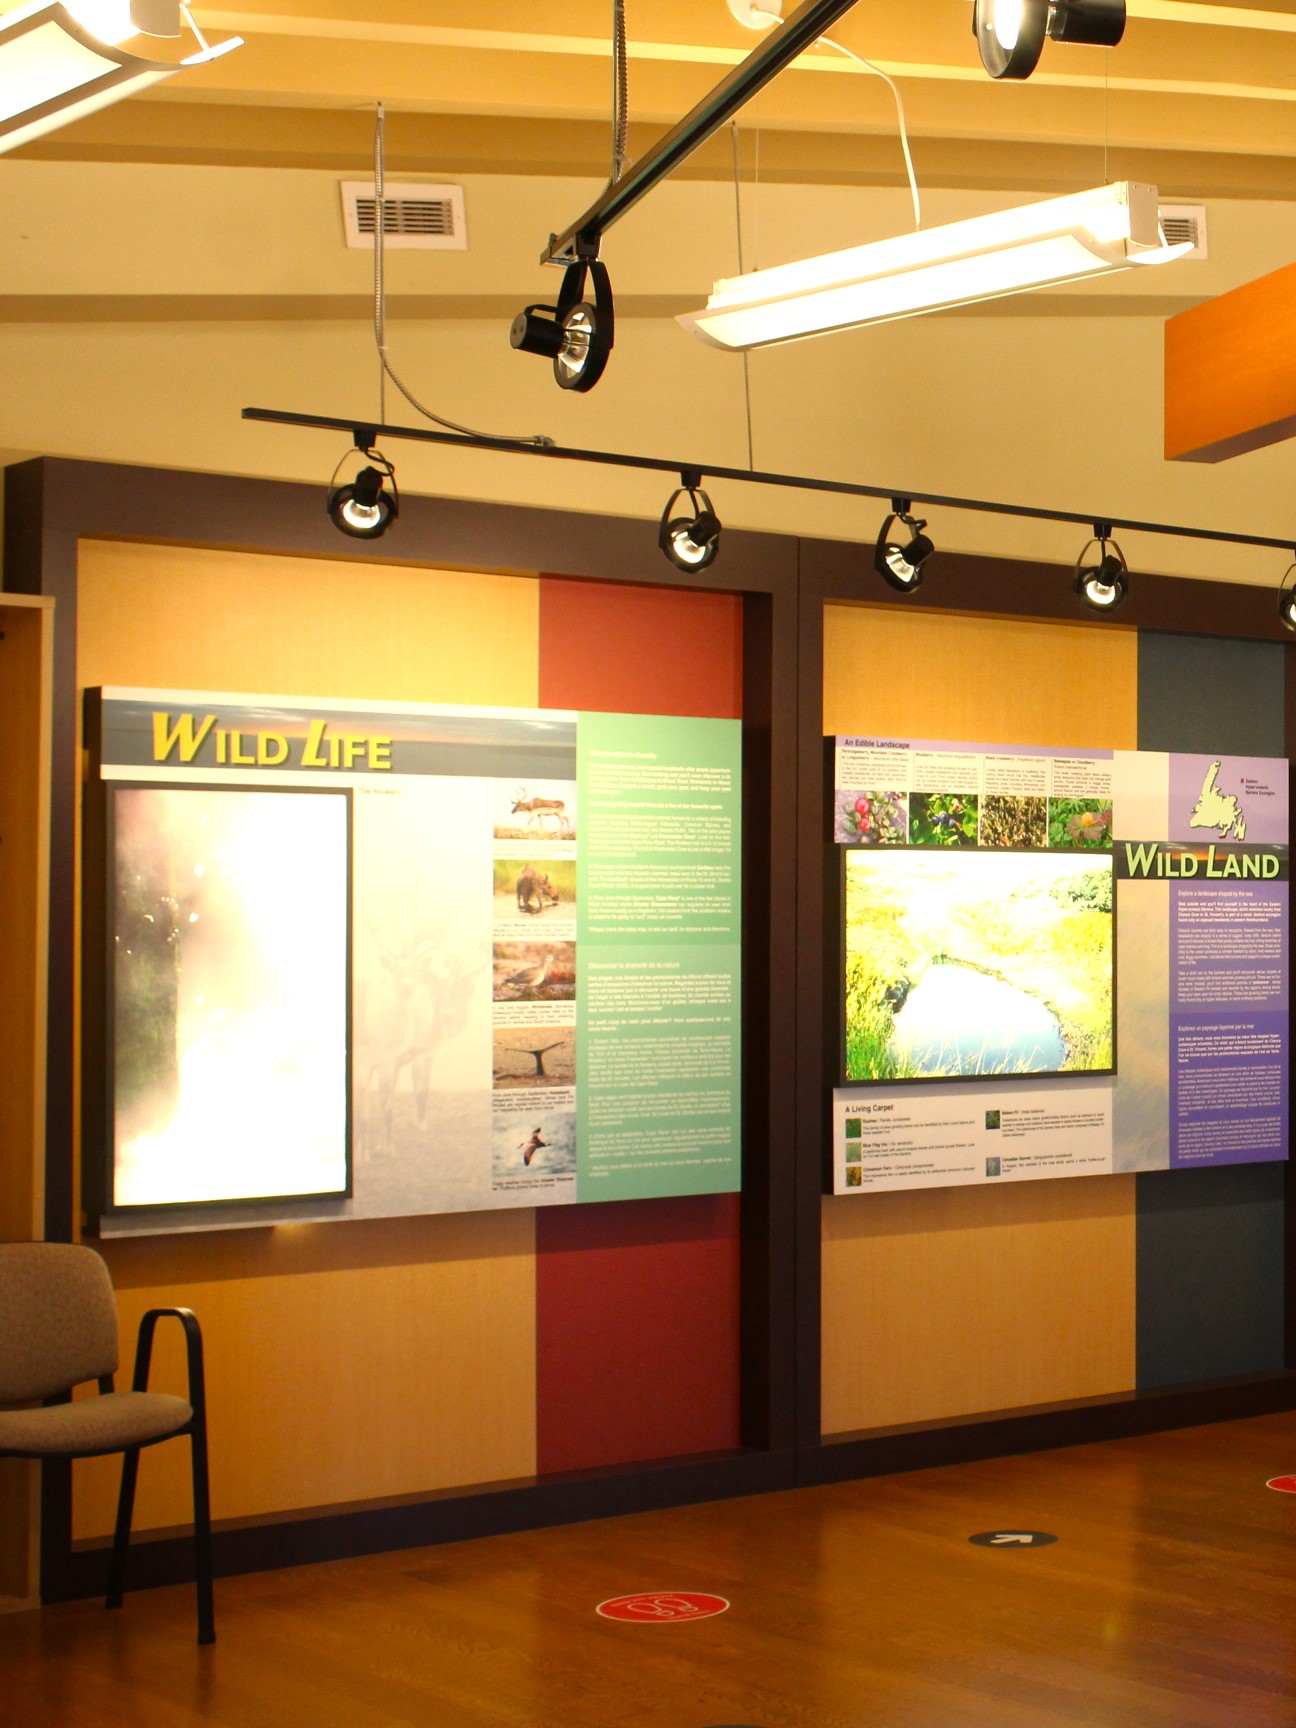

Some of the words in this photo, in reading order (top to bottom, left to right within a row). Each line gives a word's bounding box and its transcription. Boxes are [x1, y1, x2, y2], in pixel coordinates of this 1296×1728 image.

[153, 712, 289, 765] WILD
[300, 719, 391, 769] LIFE
[876, 740, 910, 749] Landscape
[1125, 843, 1198, 877] WILD
[1206, 845, 1279, 878] LAND
[852, 1105, 871, 1113] Living
